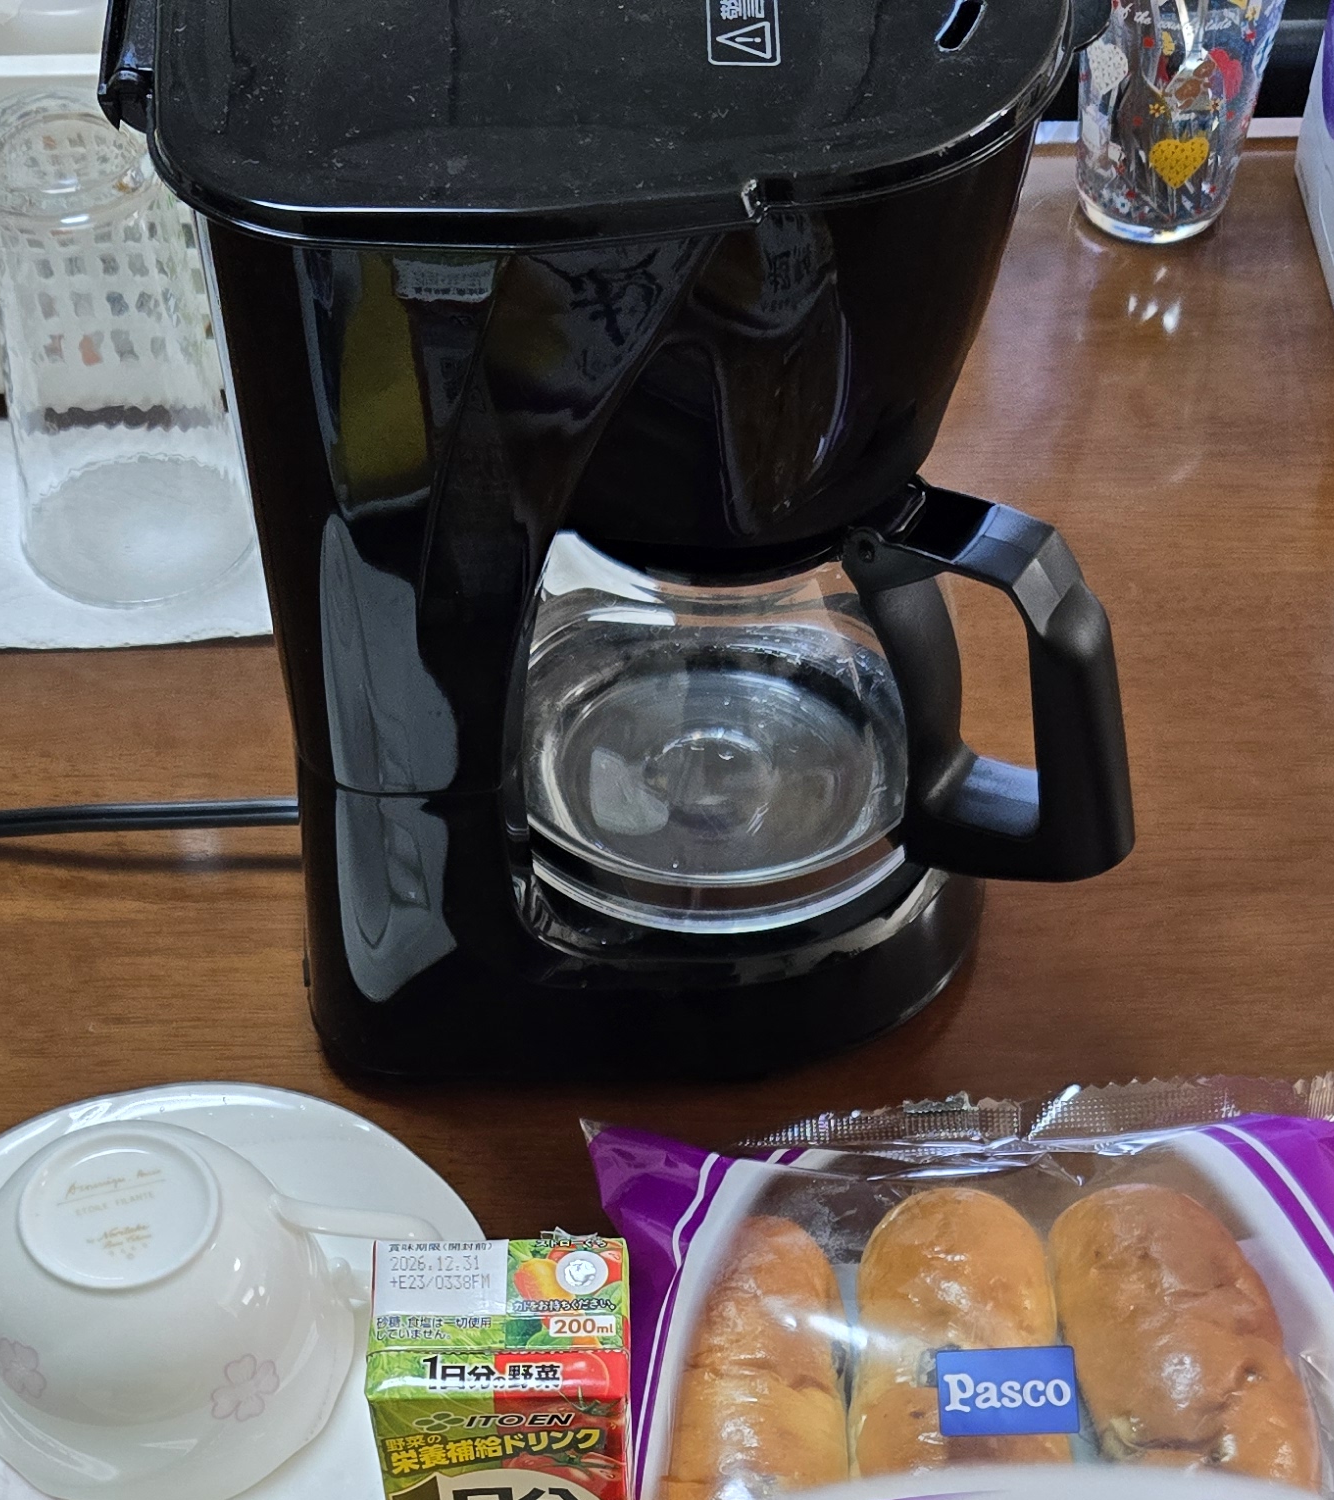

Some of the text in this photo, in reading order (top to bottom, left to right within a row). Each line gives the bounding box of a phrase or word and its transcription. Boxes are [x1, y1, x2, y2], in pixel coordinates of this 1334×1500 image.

[389, 1254, 481, 1273] 2026.12.31
[376, 1315, 493, 1330] 砂糖、食塩は一切使用
[552, 1317, 614, 1335] 200ml
[376, 1328, 452, 1340] していません。
[422, 1354, 562, 1391] 1日分の野菜
[943, 1372, 1072, 1414] Pasco
[466, 1413, 575, 1428] ITO EN
[385, 1434, 442, 1452] 野菜の
[390, 1428, 602, 1475] 栄養補給ドリンク
